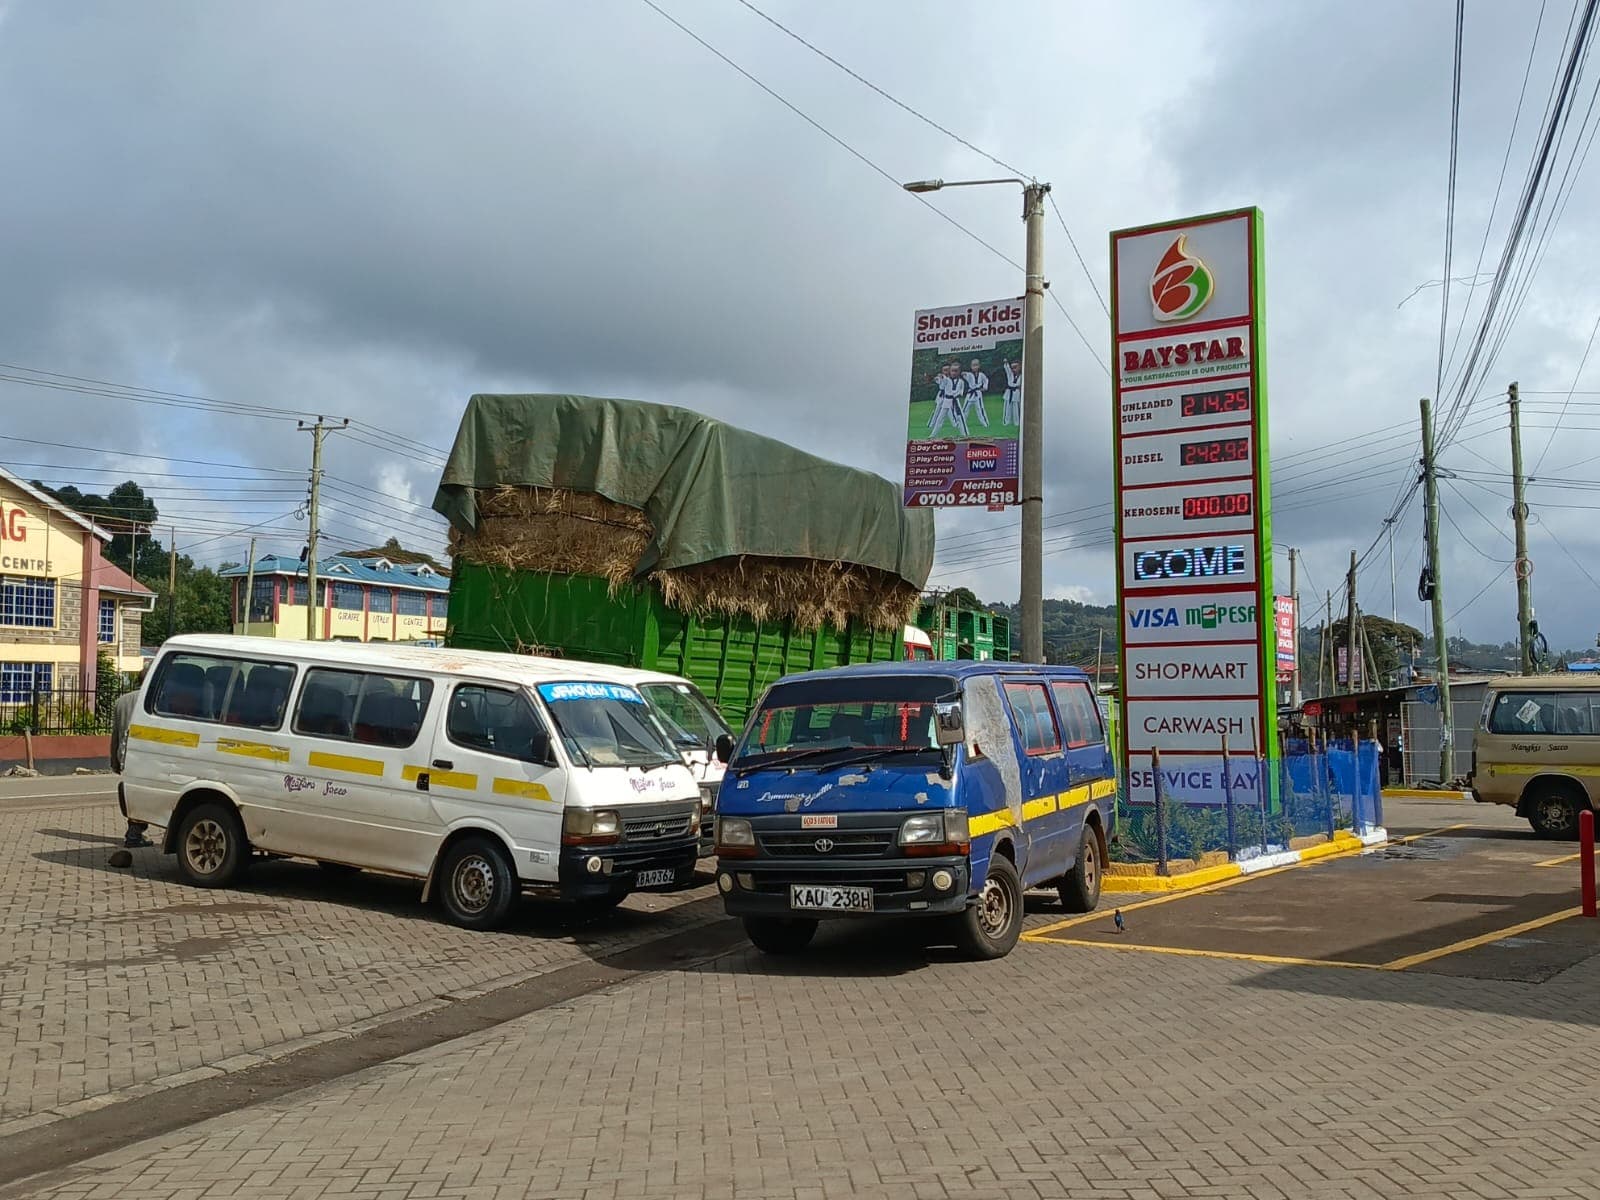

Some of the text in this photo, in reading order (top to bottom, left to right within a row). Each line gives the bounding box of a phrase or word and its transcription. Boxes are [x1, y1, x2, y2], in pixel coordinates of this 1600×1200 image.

[917, 305, 1021, 331] Shani Kids
[916, 321, 1020, 343] Garden School
[1123, 337, 1244, 371] BAYSTAR
[1143, 370, 1190, 380] SATISFACTION
[1200, 366, 1214, 374] OUR
[1122, 398, 1173, 412] UNLEADED
[1183, 391, 1248, 416] 214.25
[1121, 412, 1152, 423] SUPER
[967, 449, 997, 458] ENROLL
[1124, 453, 1164, 465] DIESEL
[1185, 440, 1248, 464] 242.92
[972, 460, 995, 469] NOW
[915, 479, 943, 487] Primary
[962, 481, 1003, 490] Merisho
[919, 491, 1014, 505] 0700 248 518
[1184, 494, 1248, 516] 000.00
[1124, 505, 1180, 518] KEROSENE
[2, 556, 53, 573] CENTRE
[1136, 545, 1245, 579] COME
[1128, 607, 1179, 628] VISA
[1135, 663, 1249, 679] SHOPMART
[1143, 717, 1243, 734] CARWASH
[1547, 743, 1568, 752] Sacco
[793, 888, 871, 908] KAU 238H
